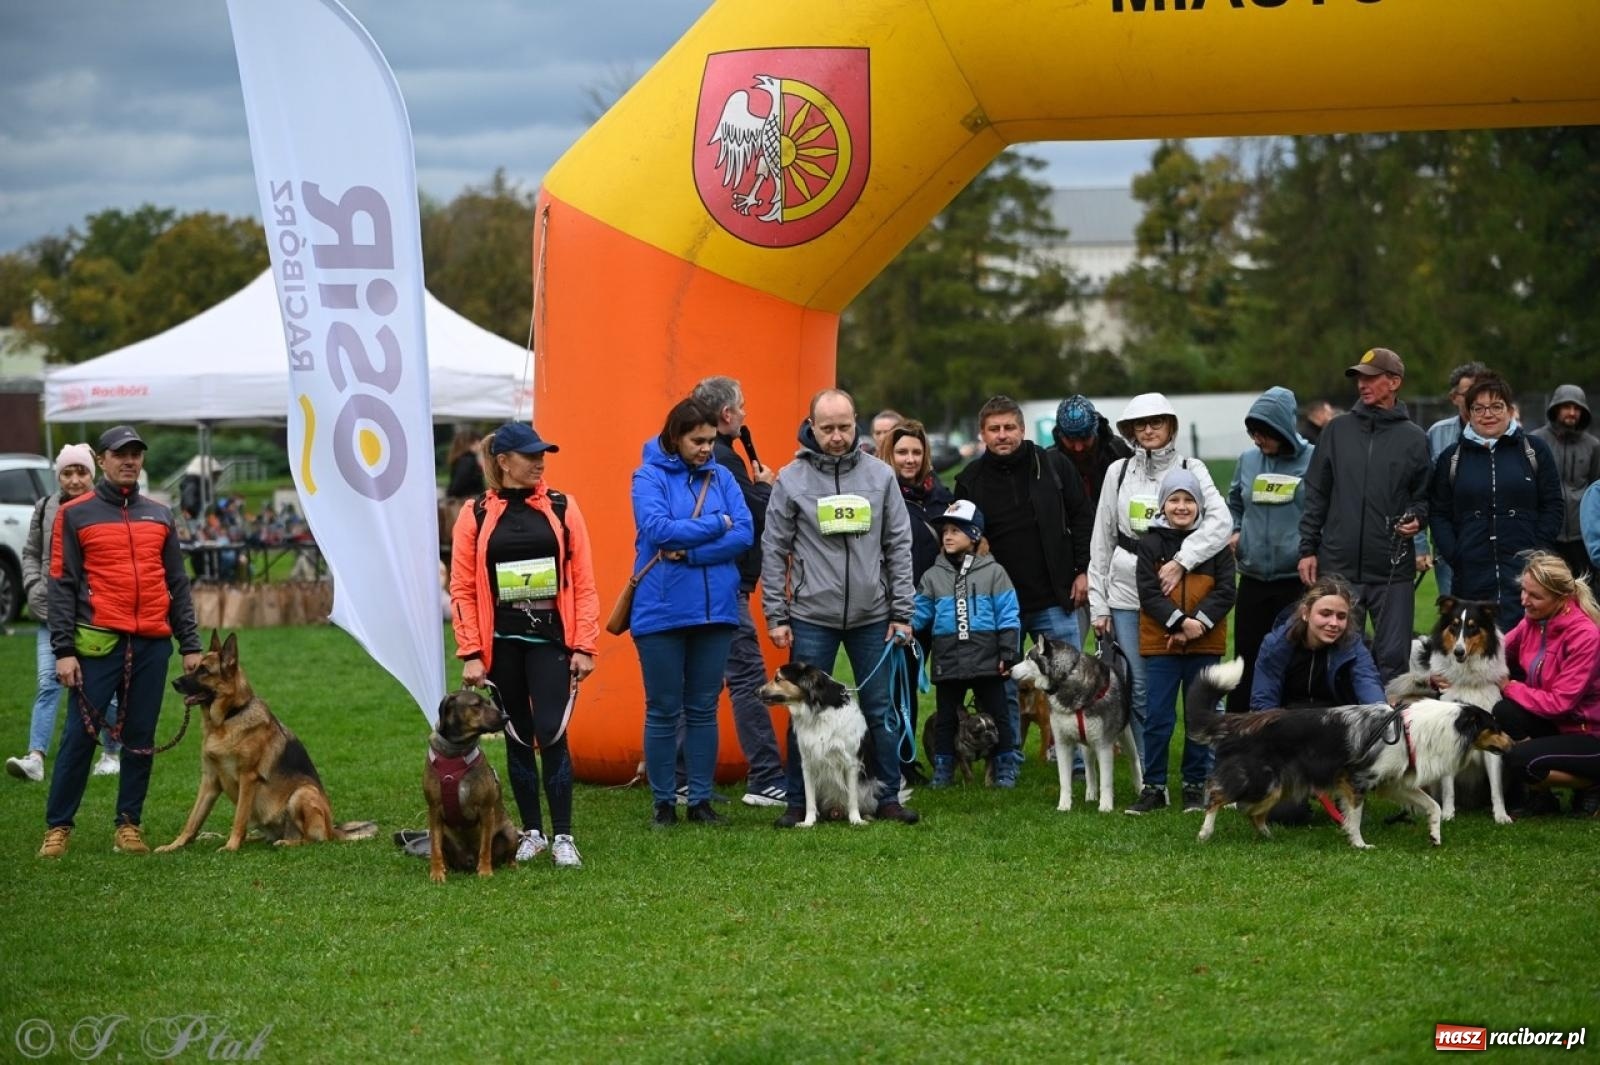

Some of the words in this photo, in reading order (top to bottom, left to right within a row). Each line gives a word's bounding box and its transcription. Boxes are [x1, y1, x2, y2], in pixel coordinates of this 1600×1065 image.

[1265, 483, 1284, 494] 87
[834, 507, 856, 520] 83
[521, 573, 533, 586] 7
